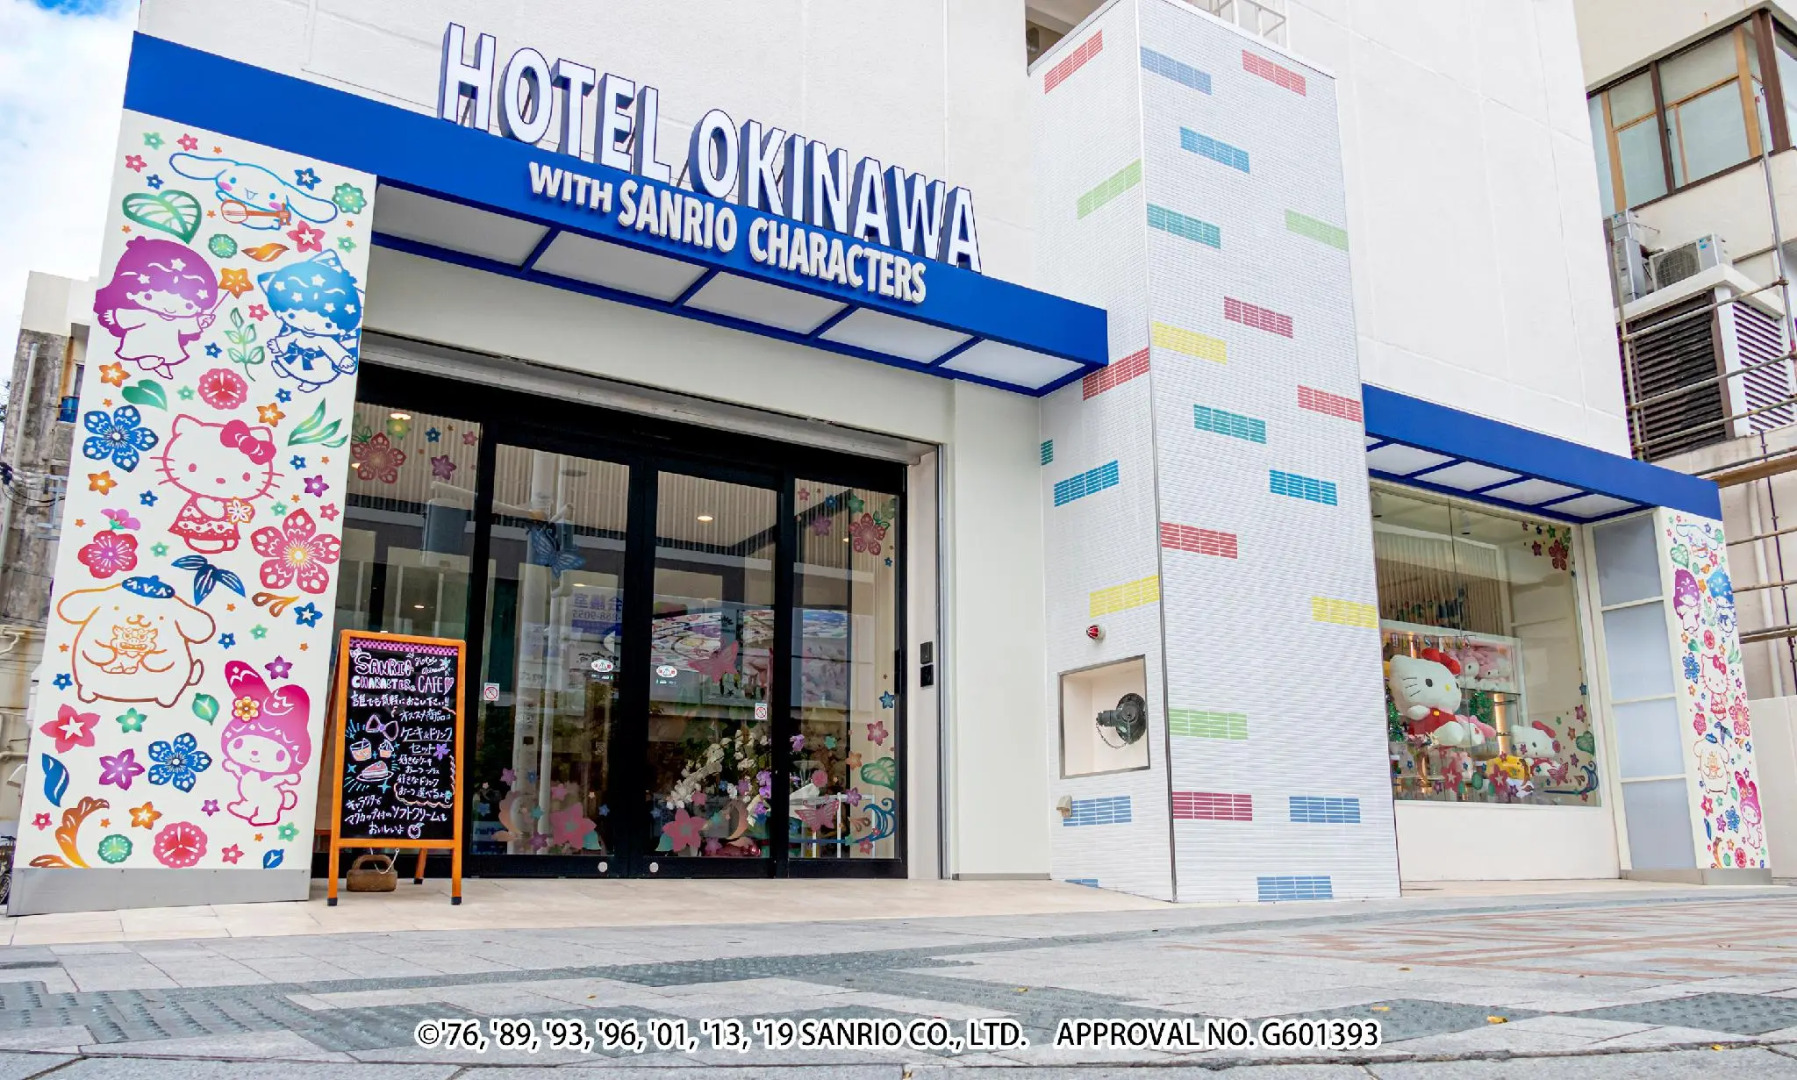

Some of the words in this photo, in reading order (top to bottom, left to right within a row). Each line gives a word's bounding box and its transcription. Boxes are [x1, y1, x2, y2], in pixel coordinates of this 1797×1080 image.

[438, 21, 672, 183] HOTEL
[688, 108, 982, 275] OKINAWA
[529, 161, 612, 213] WITH
[618, 179, 737, 253] SANRIO
[748, 216, 926, 305] CHARACTERS
[354, 651, 413, 676] SANRIO
[418, 675, 443, 694] CAFE
